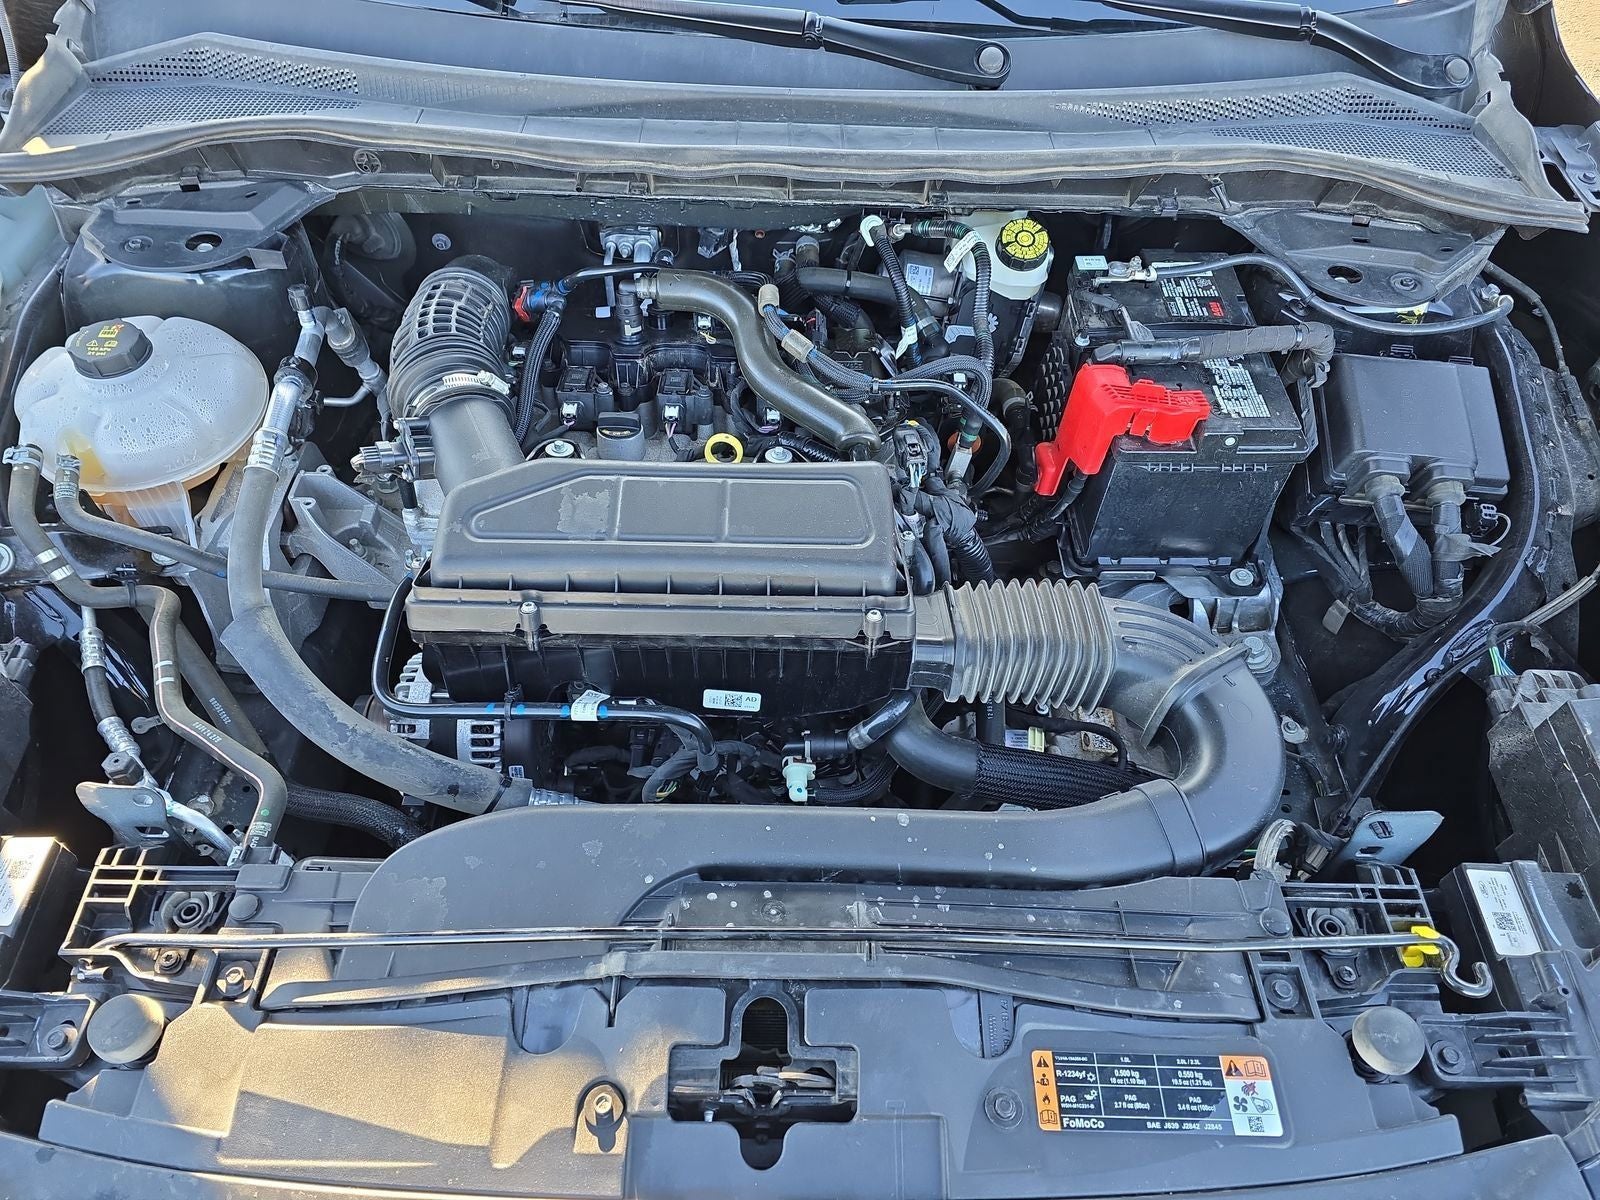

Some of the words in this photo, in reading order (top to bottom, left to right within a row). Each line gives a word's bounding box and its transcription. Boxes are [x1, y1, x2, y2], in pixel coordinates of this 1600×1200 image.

[1056, 1070, 1086, 1079] R-1234yf
[1114, 1069, 1130, 1077] 0.500
[1131, 1070, 1140, 1078] kg
[1194, 1070, 1203, 1080] kg
[1198, 1104, 1216, 1112] (100cc)
[1063, 1118, 1104, 1128] FoMoCo
